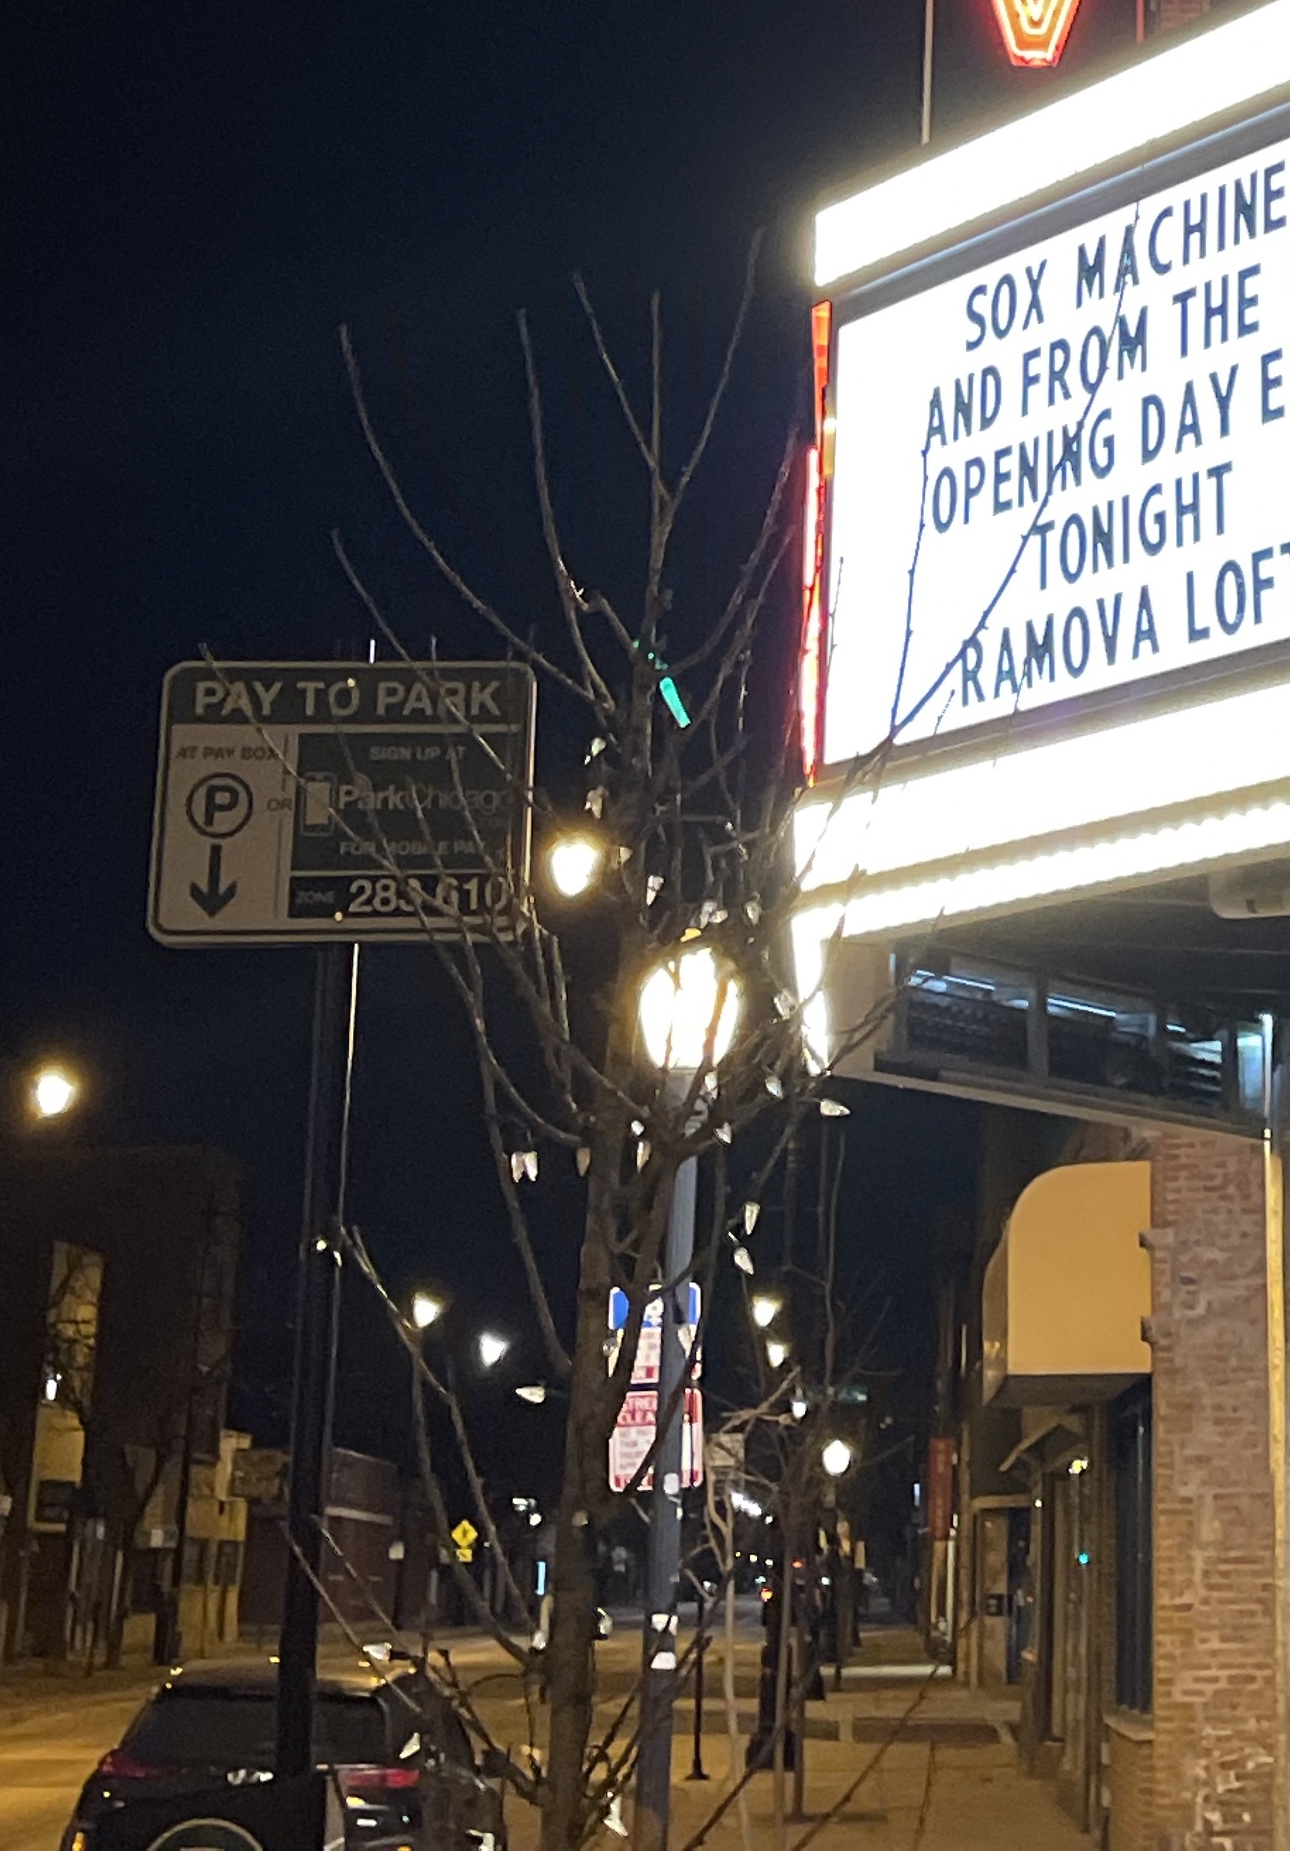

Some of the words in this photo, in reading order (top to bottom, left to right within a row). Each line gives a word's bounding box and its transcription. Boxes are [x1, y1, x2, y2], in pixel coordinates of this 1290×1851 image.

[965, 259, 1047, 352] SOX
[1075, 159, 1287, 309] MACHINE
[926, 365, 1001, 449] AND
[1021, 306, 1148, 416] FROM
[1173, 263, 1261, 358] THE
[932, 407, 1115, 535] OPENING
[1141, 363, 1239, 465] DAY
[1031, 461, 1234, 591] TONIGHT
[194, 681, 281, 716] PAY
[298, 680, 361, 717] TO
[376, 681, 502, 716] PARK
[959, 584, 1159, 707] RAMOVA
[203, 746, 235, 760] PAY
[267, 798, 292, 812] OR
